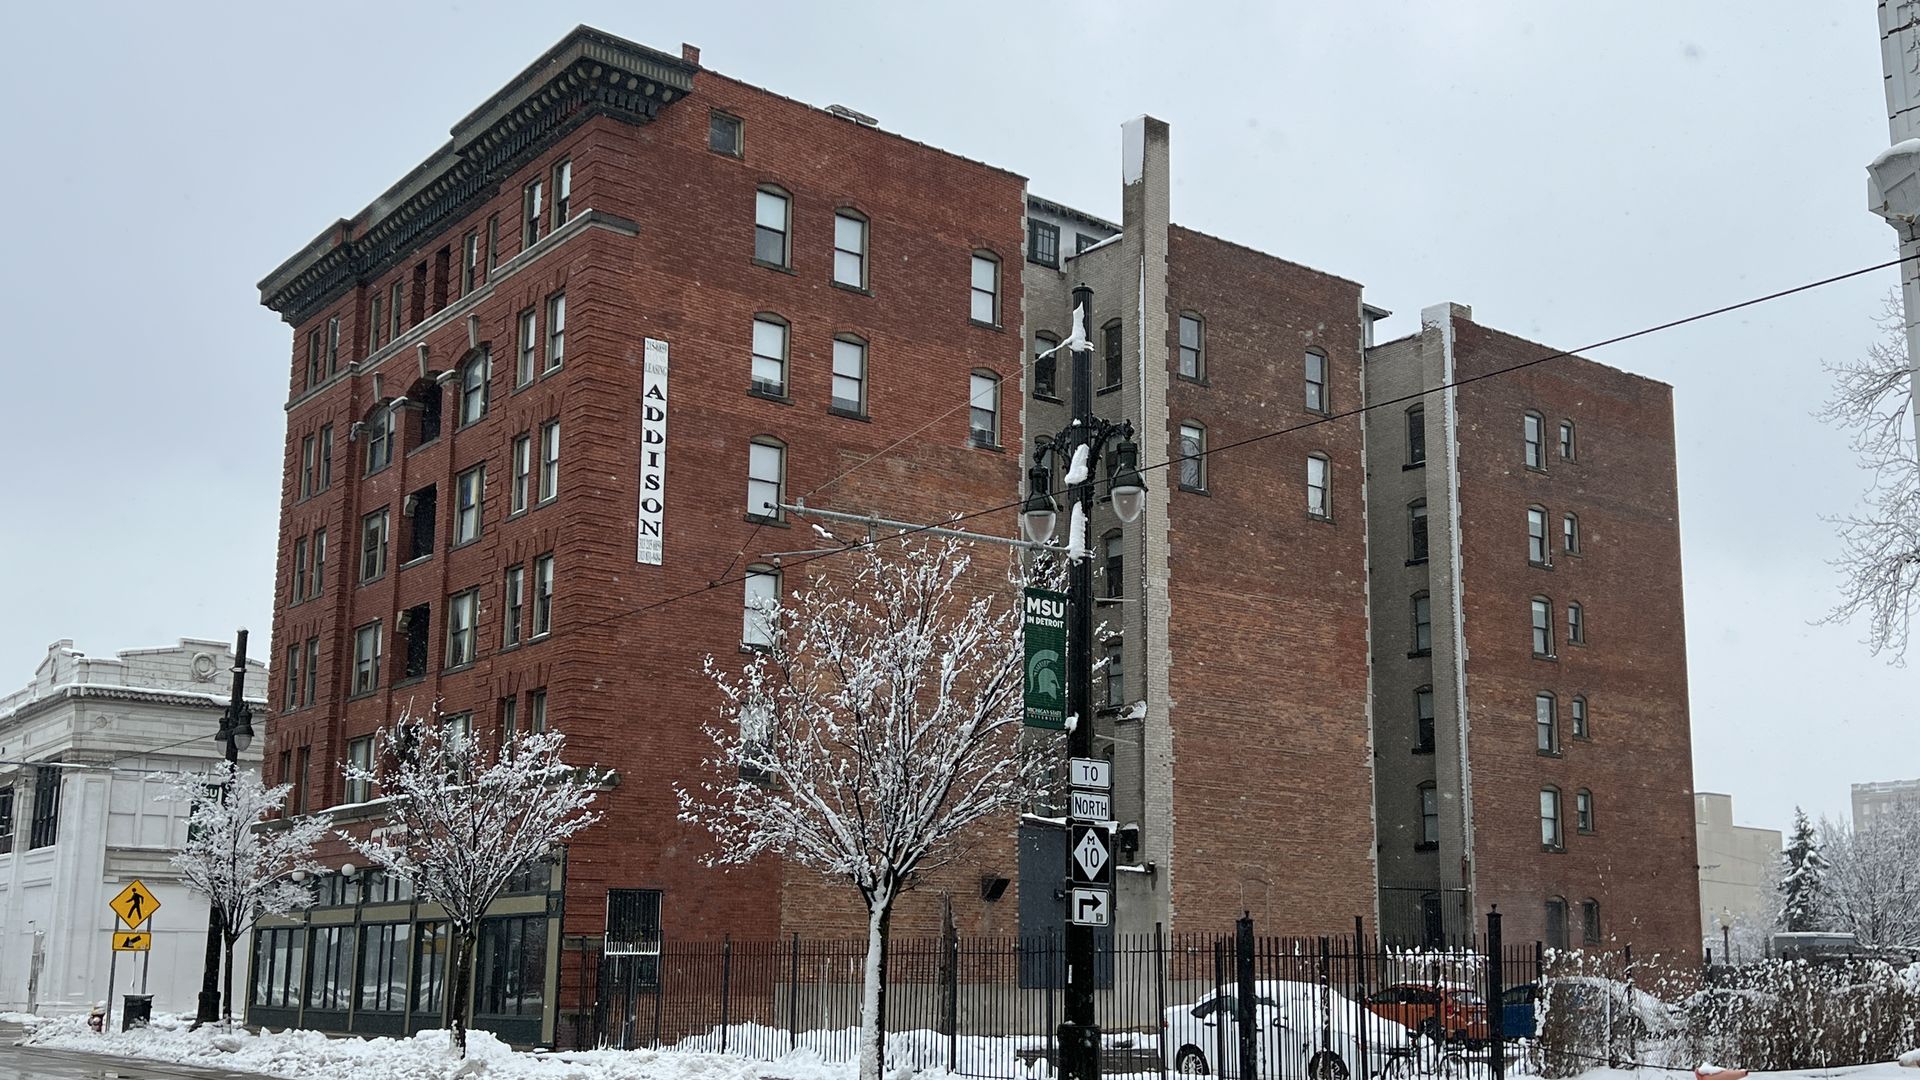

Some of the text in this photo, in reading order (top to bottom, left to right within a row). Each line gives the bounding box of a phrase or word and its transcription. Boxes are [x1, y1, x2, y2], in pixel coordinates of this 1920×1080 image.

[640, 384, 666, 538] ADDISON
[1026, 596, 1064, 618] MSU
[1026, 615, 1064, 629] IN DETROIT
[1026, 706, 1050, 715] MICHIGAN
[1083, 765, 1098, 781] TO
[1075, 796, 1107, 816] NORTH
[1087, 836, 1095, 845] M
[1084, 847, 1099, 868] 10
